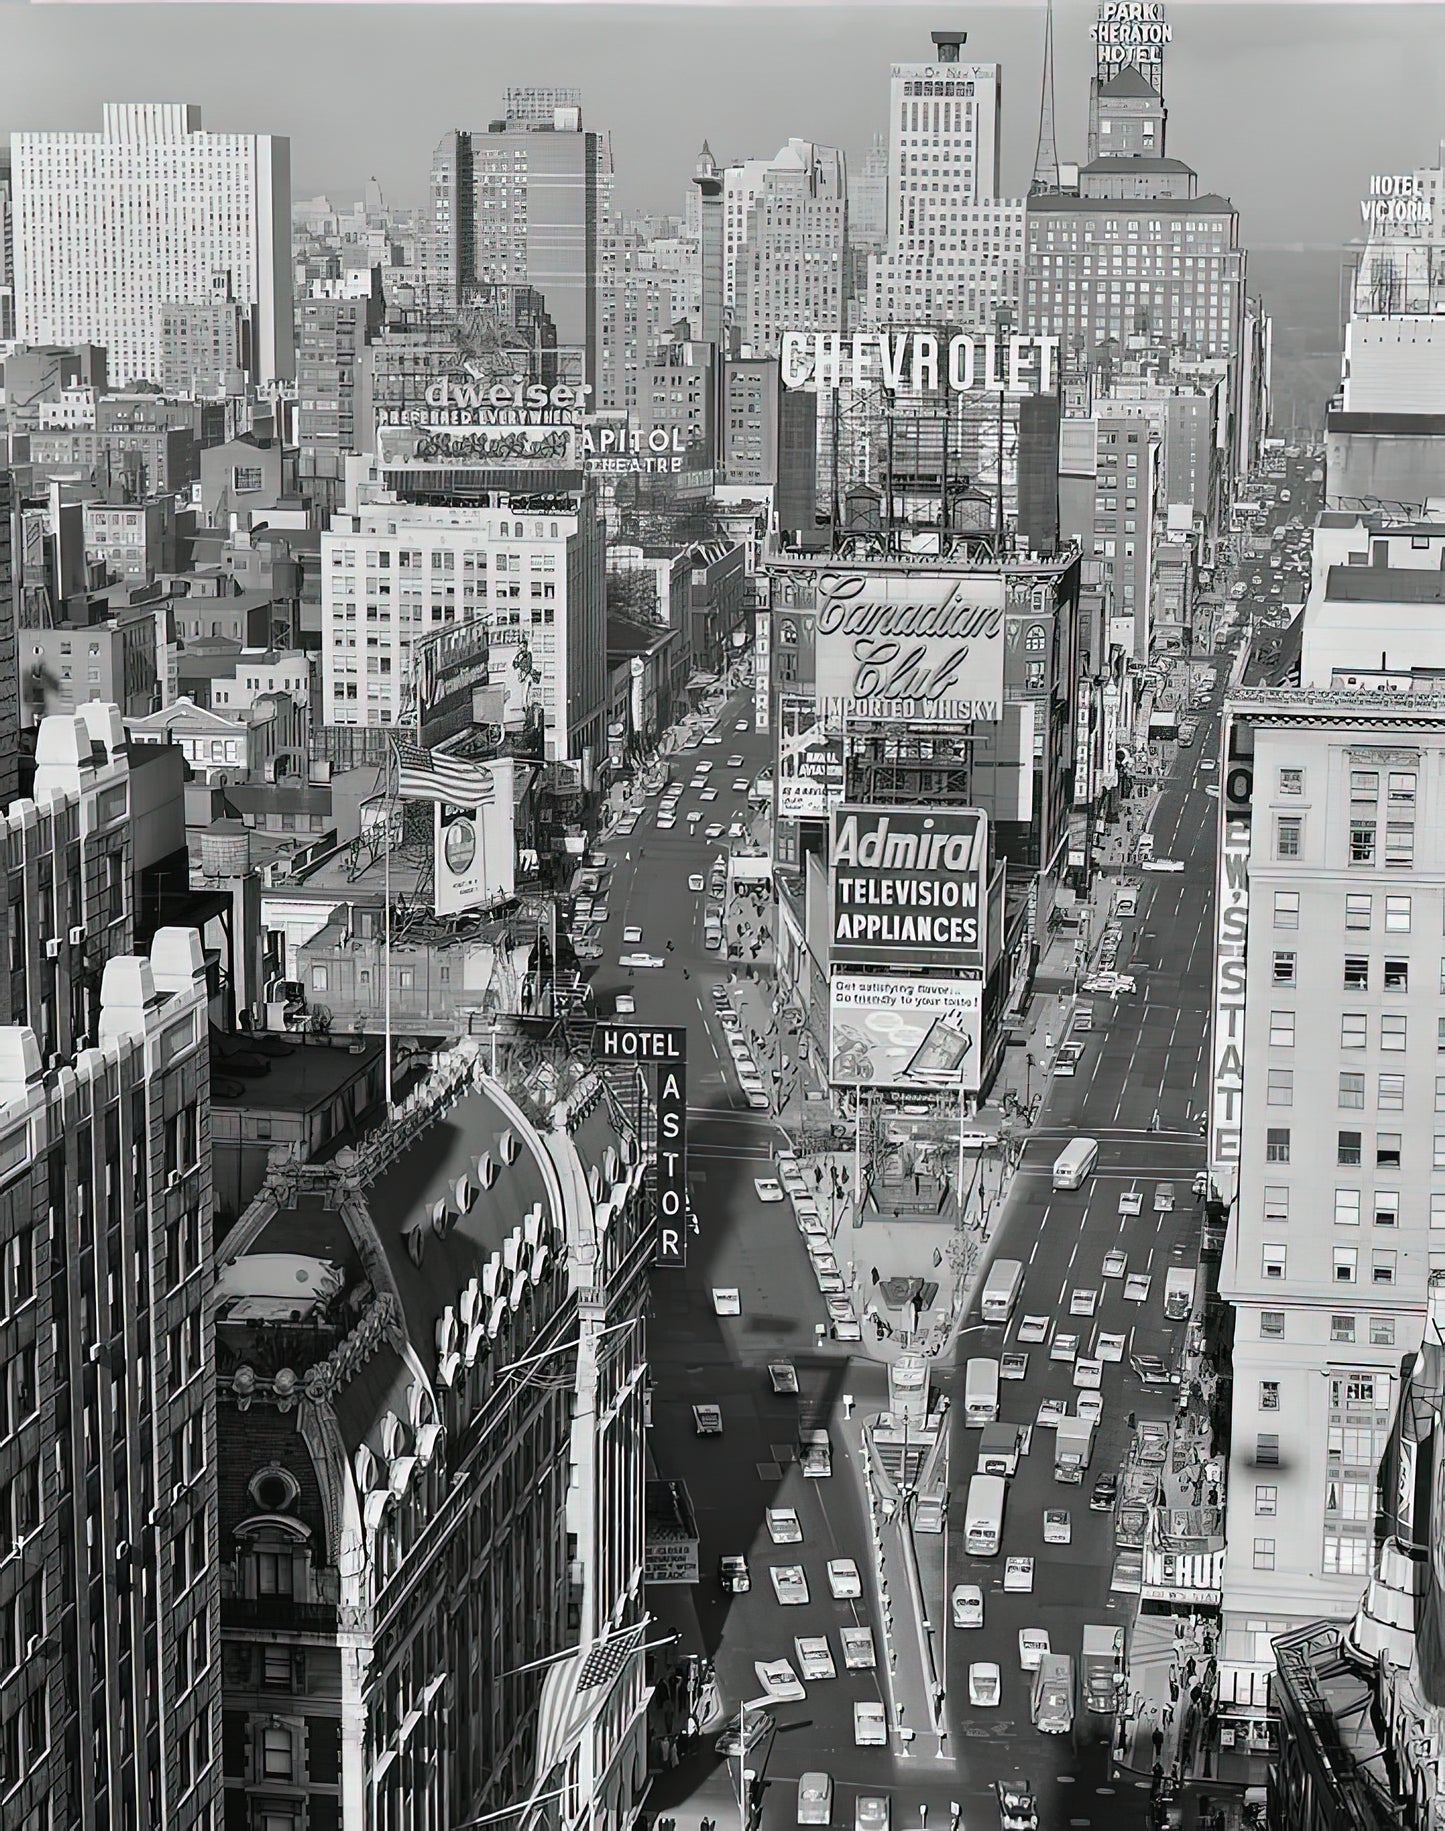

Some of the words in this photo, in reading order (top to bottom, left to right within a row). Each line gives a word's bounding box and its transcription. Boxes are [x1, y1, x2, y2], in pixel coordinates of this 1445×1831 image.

[1103, 2, 1157, 21] PARK
[1089, 23, 1172, 43] SHERATON
[1098, 44, 1162, 63] HOTEL
[1370, 175, 1422, 196] HOTEL
[1361, 199, 1432, 222] VICTORIA
[781, 331, 1060, 393] CHEVROLET
[582, 428, 686, 452] APITOL
[586, 457, 683, 472] THEATRE
[817, 573, 1004, 638] Canadian
[853, 638, 969, 700] Club
[823, 698, 914, 718] IMPORTED
[921, 700, 996, 720] WHISKY
[831, 815, 985, 871] Admiral
[838, 878, 977, 908] TELEVISION
[836, 913, 977, 943] APPLIANCES
[901, 996, 912, 1004] to
[915, 998, 941, 1007] your
[604, 1030, 680, 1057] HOTEL
[1215, 960, 1246, 1162] STATE
[662, 1072, 681, 1256] ASTOR
